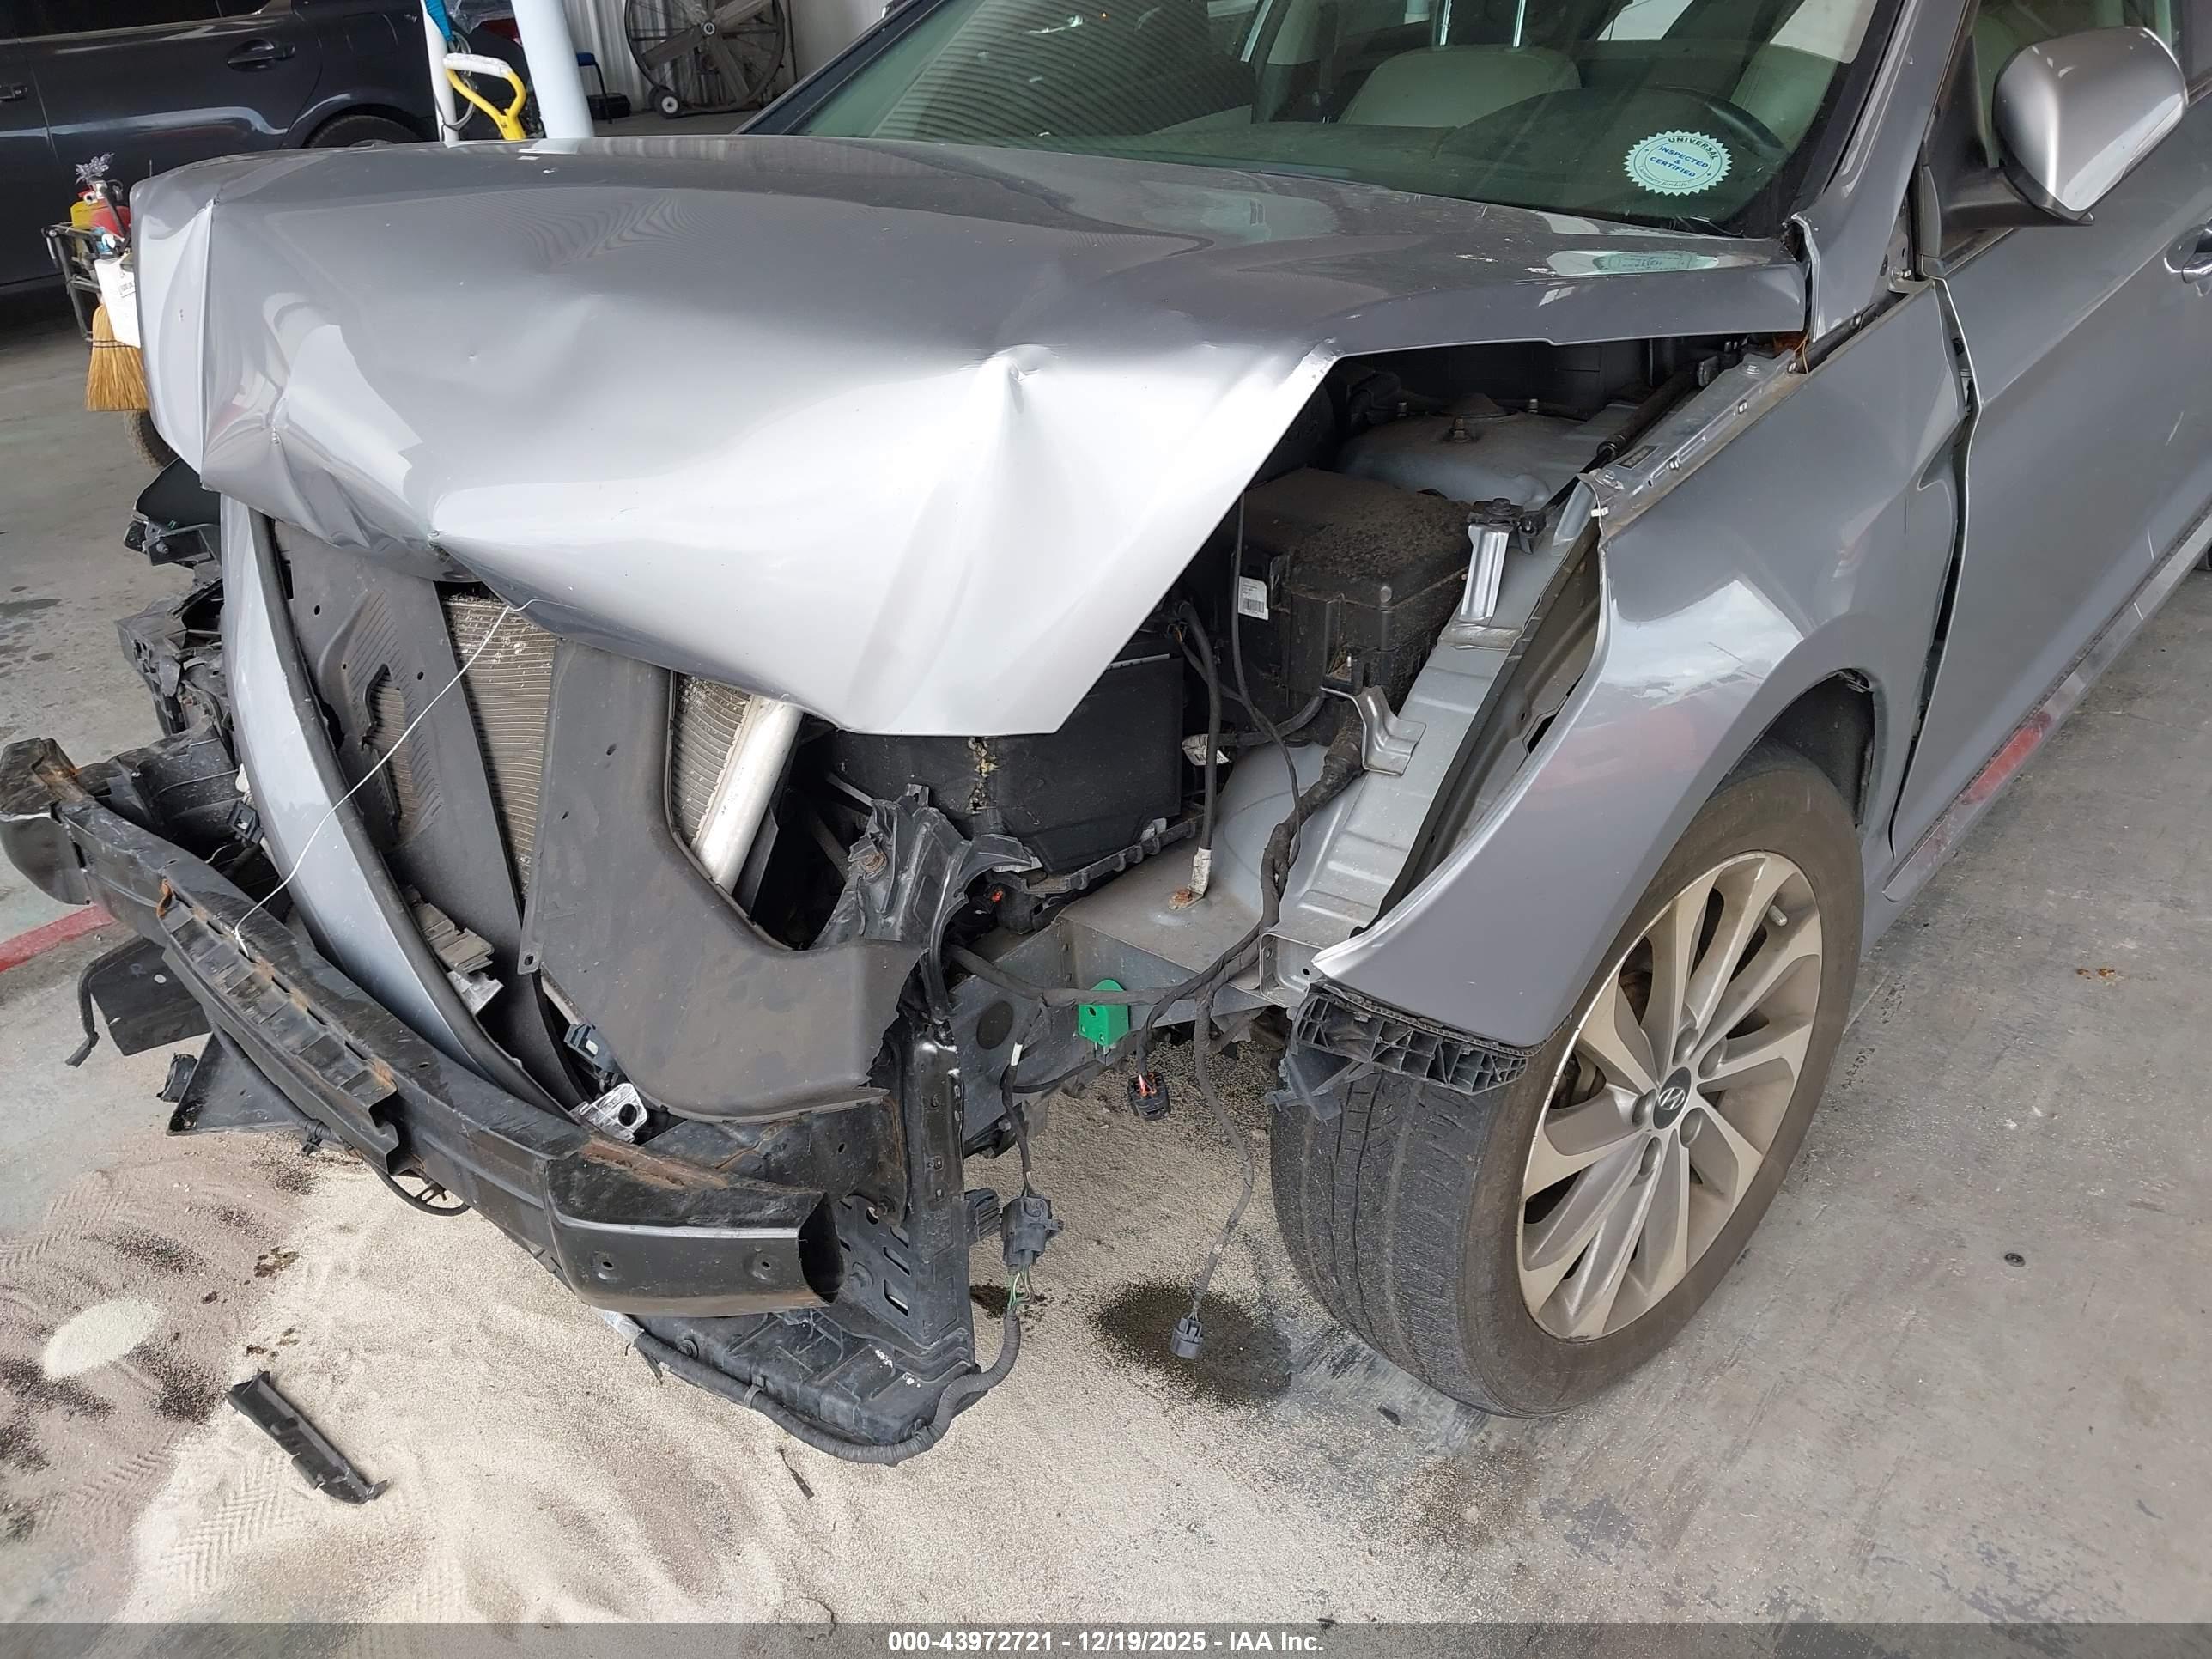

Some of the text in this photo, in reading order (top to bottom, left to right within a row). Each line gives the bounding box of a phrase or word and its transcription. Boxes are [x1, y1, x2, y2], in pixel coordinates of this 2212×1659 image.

[1657, 146, 1709, 168] INSPECTED
[1668, 137, 1719, 160] UNIVERSAL
[1650, 156, 1697, 178] CERTIFIED
